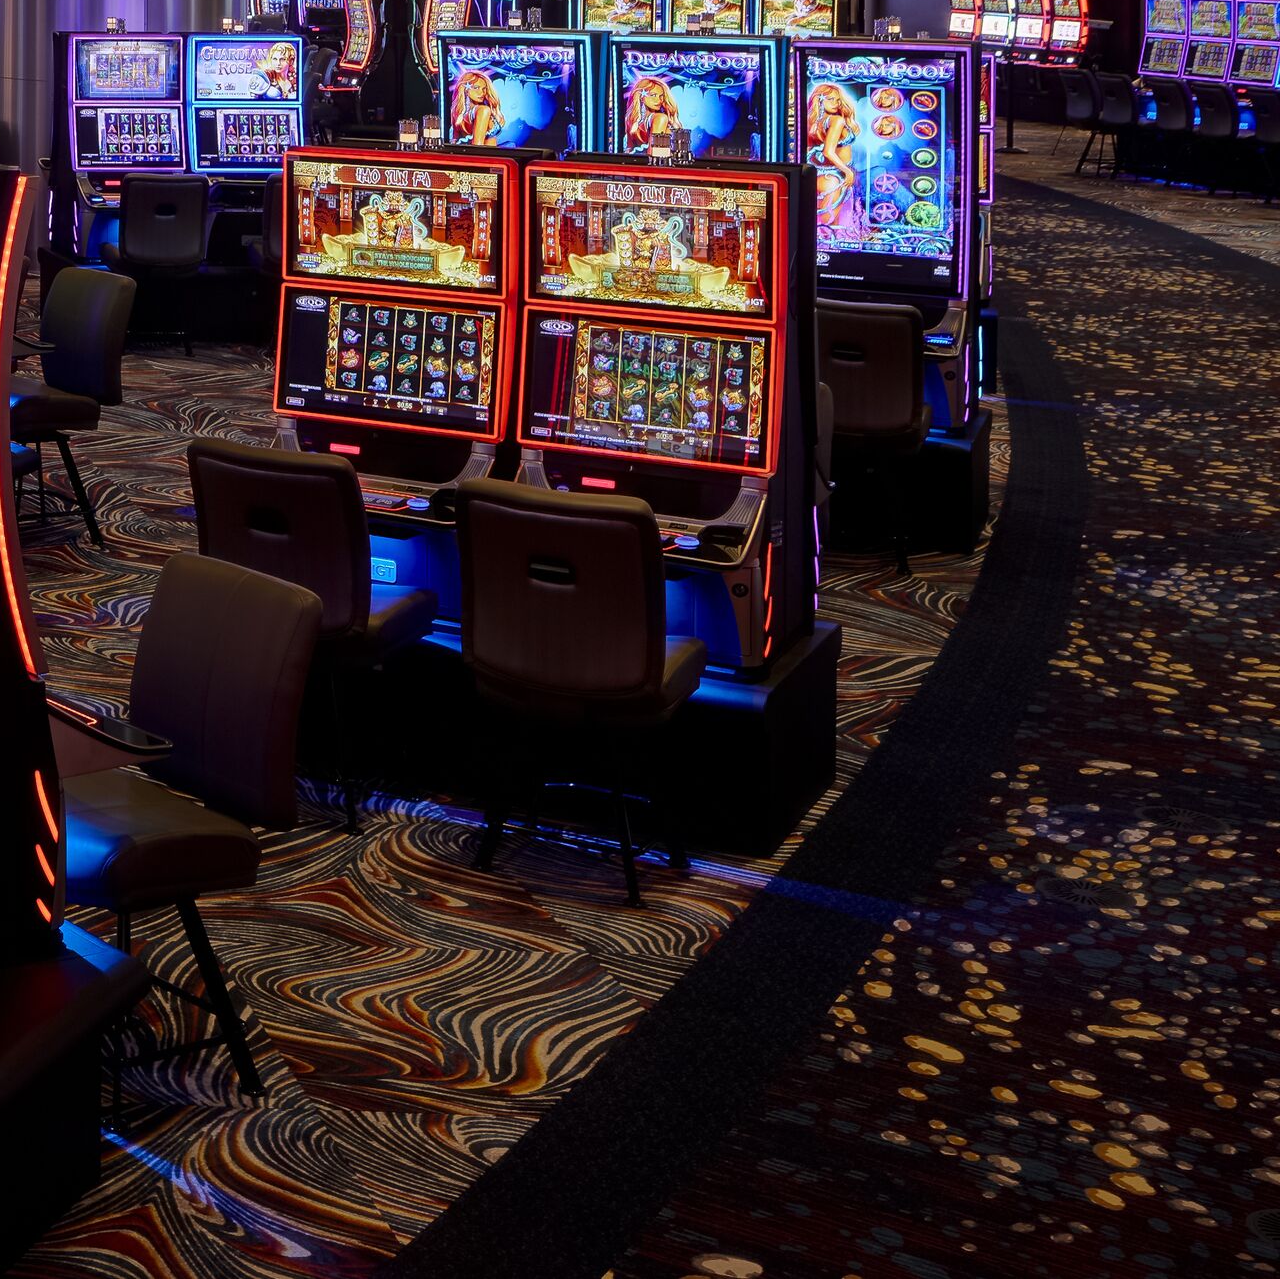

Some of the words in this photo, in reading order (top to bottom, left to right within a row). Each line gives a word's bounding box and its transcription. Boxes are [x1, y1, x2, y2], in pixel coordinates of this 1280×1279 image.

[200, 46, 269, 61] GUARDIAN
[450, 45, 518, 65] DREAM
[521, 49, 575, 64] POOL
[626, 50, 694, 71] DREAM
[697, 55, 758, 71] POOL
[218, 62, 253, 75] ROSE
[814, 60, 887, 77] DREAM
[891, 63, 952, 78] POOL
[356, 167, 380, 183] HAO
[384, 169, 408, 187] YUN
[412, 171, 431, 187] FA
[606, 183, 633, 201] HAO
[639, 185, 665, 203] YUN
[670, 187, 691, 205] FA
[751, 298, 764, 306] IGT
